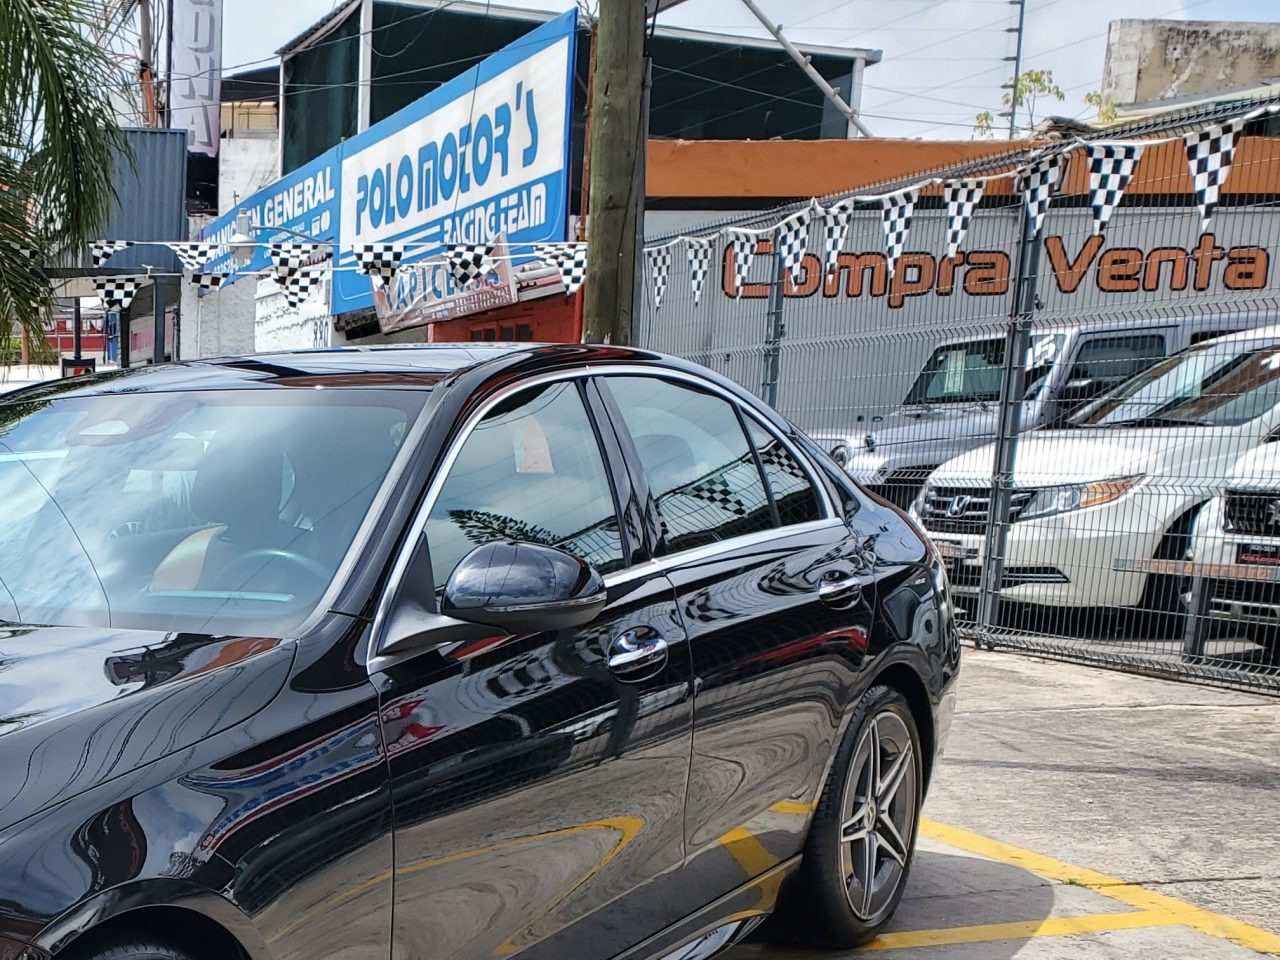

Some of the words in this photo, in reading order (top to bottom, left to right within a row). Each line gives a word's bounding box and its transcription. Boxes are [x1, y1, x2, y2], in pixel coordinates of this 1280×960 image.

[179, 0, 216, 147] ONA
[355, 154, 414, 236] POLO
[417, 80, 539, 213] MOTOR'S
[263, 166, 336, 228] GENERAL
[443, 200, 497, 245] RACING
[498, 181, 547, 234] TEAM
[721, 238, 1011, 309] Compra
[1043, 232, 1270, 294] Venta
